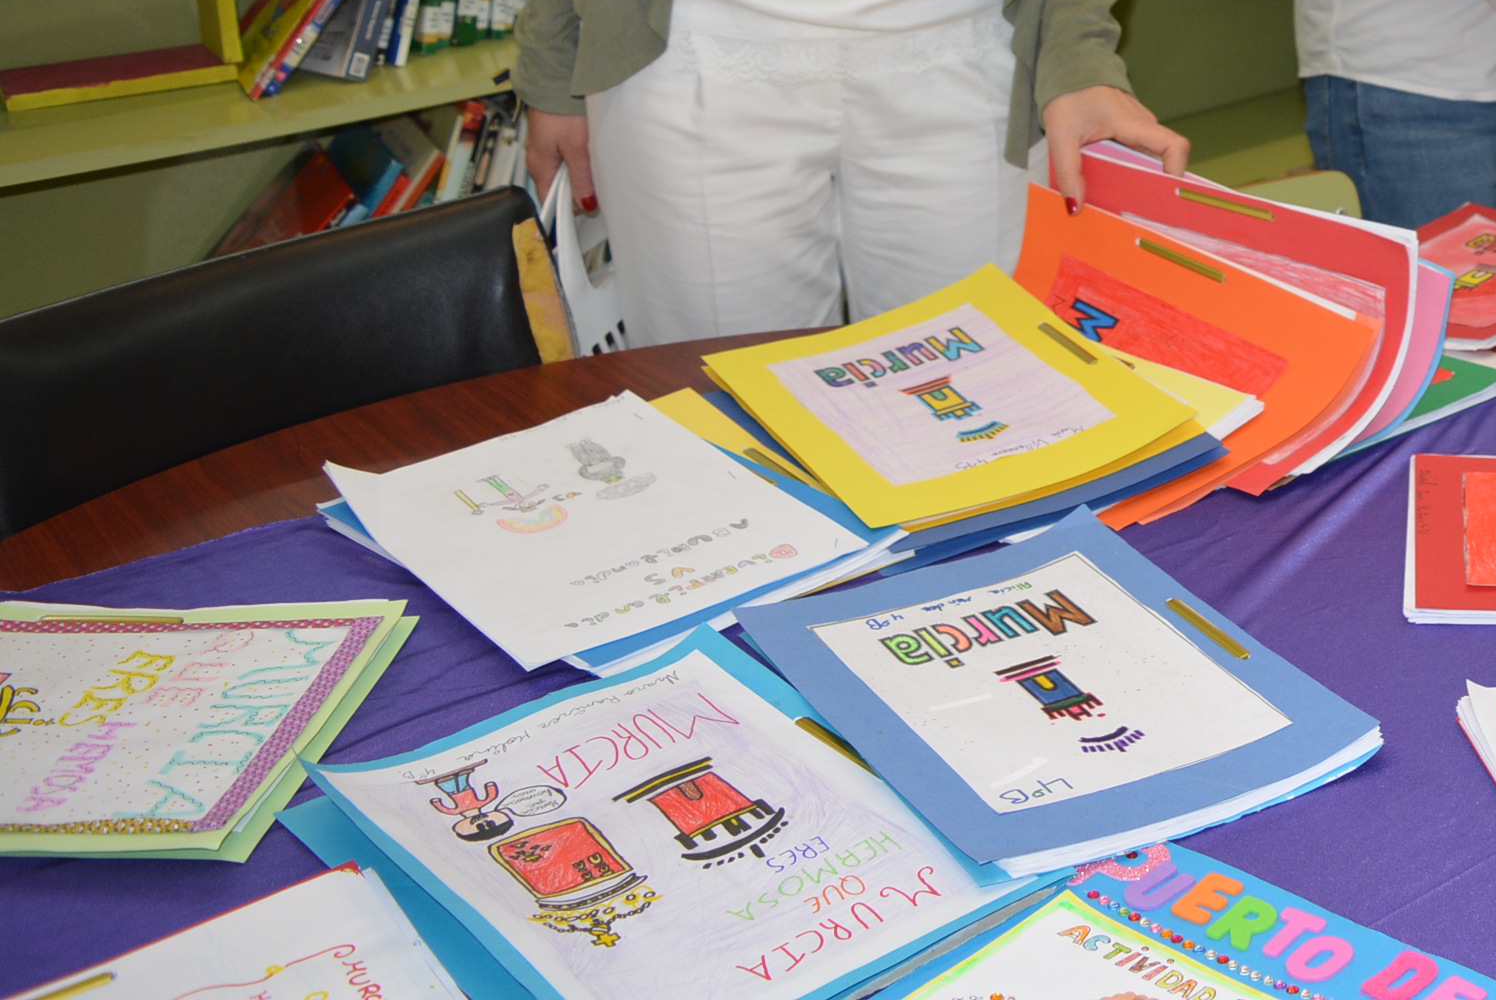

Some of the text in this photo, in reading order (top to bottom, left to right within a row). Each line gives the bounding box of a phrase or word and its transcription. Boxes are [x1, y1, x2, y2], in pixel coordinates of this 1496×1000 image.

[813, 326, 985, 389] Murcia
[138, 628, 254, 709] QUE
[877, 588, 1096, 670] Murcia
[57, 650, 178, 727] ERES
[112, 628, 338, 823] MURCIA
[535, 690, 740, 790] MURCIA
[998, 777, 1074, 805] 4ºB
[725, 828, 904, 923] HERMOSA
[763, 834, 831, 874] ERES
[802, 873, 868, 915] QUE
[734, 863, 943, 982] MURCIA
[1067, 841, 1354, 983] PUERTO
